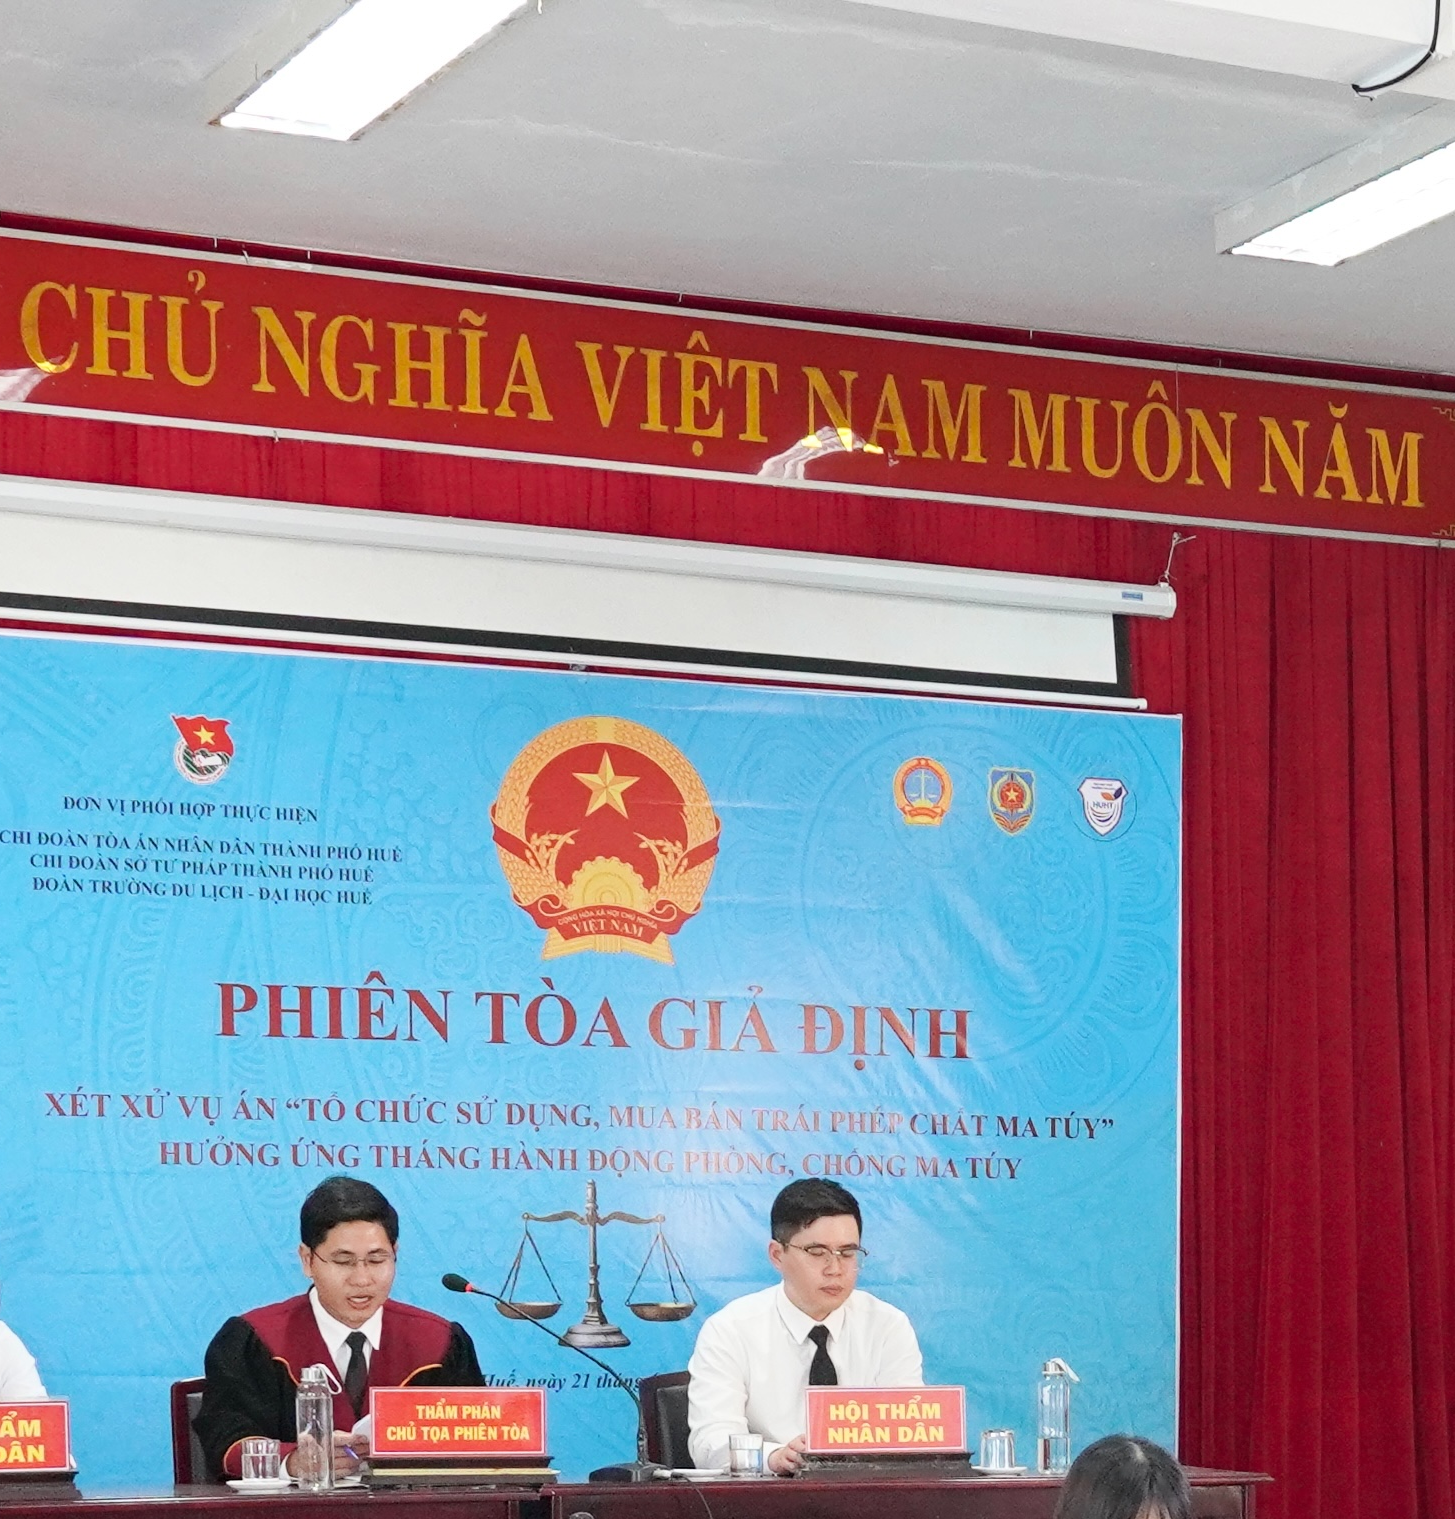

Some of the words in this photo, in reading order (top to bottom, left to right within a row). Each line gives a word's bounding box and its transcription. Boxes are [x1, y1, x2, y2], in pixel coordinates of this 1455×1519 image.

[17, 269, 222, 389] CHỦ
[249, 310, 555, 423] NGHĨA
[576, 331, 779, 457] VIỆT
[802, 366, 989, 467] NAM
[1009, 379, 1239, 490] MUÔN
[1257, 392, 1428, 511] NĂM
[64, 796, 101, 810] ĐƠN
[107, 799, 125, 816] VỊ
[180, 800, 215, 820] HỢP
[220, 804, 270, 823] THỰC
[276, 807, 318, 825] HIỆN
[0, 830, 31, 844] CHI
[38, 829, 88, 847] ĐOÀN
[93, 832, 131, 849] TÒA
[135, 833, 159, 851] ÁN
[165, 833, 214, 854] NHÂN
[220, 838, 255, 855] DÂN
[260, 840, 321, 859] THÀNH
[30, 854, 62, 868] CHI
[68, 854, 119, 871] ĐOÀN
[152, 859, 178, 874] TƯ
[182, 860, 227, 877] PHÁP
[231, 861, 292, 879] THÀNH
[33, 875, 84, 893] ĐOÀN
[89, 877, 166, 896] TRƯỜNG
[172, 882, 195, 898] DU
[201, 885, 243, 903] LỊCH
[259, 887, 289, 905] ĐẠI
[295, 888, 333, 906] HỌC
[571, 918, 607, 934] VIỆT
[611, 919, 643, 938] NAM
[214, 970, 455, 1042] PHIÊN
[474, 976, 632, 1049] TÒA
[646, 985, 780, 1054] GIẢ
[797, 1002, 974, 1071] ĐỊNH
[44, 1086, 111, 1118] XÉT
[120, 1088, 171, 1119] XỬ
[178, 1096, 223, 1126] VỤ
[232, 1090, 277, 1121] ÁN
[355, 1092, 448, 1125] CHỨC
[455, 1096, 498, 1126] SỬ
[505, 1104, 600, 1134] DỤNG,
[608, 1106, 675, 1130] MUA
[684, 1101, 744, 1131] BÁN
[751, 1103, 821, 1132] TRÁI
[829, 1106, 906, 1134] PHÉP
[995, 1115, 1040, 1139] MA
[1045, 1111, 1115, 1140] TÚY”
[159, 1135, 281, 1168] HƯỞNG
[290, 1135, 360, 1169] ỨNG
[369, 1139, 481, 1170] THÁNG
[489, 1139, 580, 1171] HÀNH
[586, 1146, 675, 1177] ĐỘNG
[683, 1145, 795, 1180] PHÒNG,
[801, 1144, 907, 1179] CHỐNG
[915, 1157, 960, 1180] MA
[965, 1151, 1024, 1180] TÚY
[526, 1372, 566, 1393] ngày
[572, 1373, 590, 1388] 21
[462, 1401, 501, 1420] PHÁN
[829, 1400, 869, 1424] HỘI
[875, 1395, 942, 1420] THẨM
[386, 1421, 416, 1441] CHỦ
[421, 1425, 450, 1444] TỌA
[454, 1423, 498, 1441] PHIÊN
[501, 1422, 530, 1440] TÒA
[827, 1422, 890, 1444] NHÂN
[897, 1422, 944, 1442] DÂN
